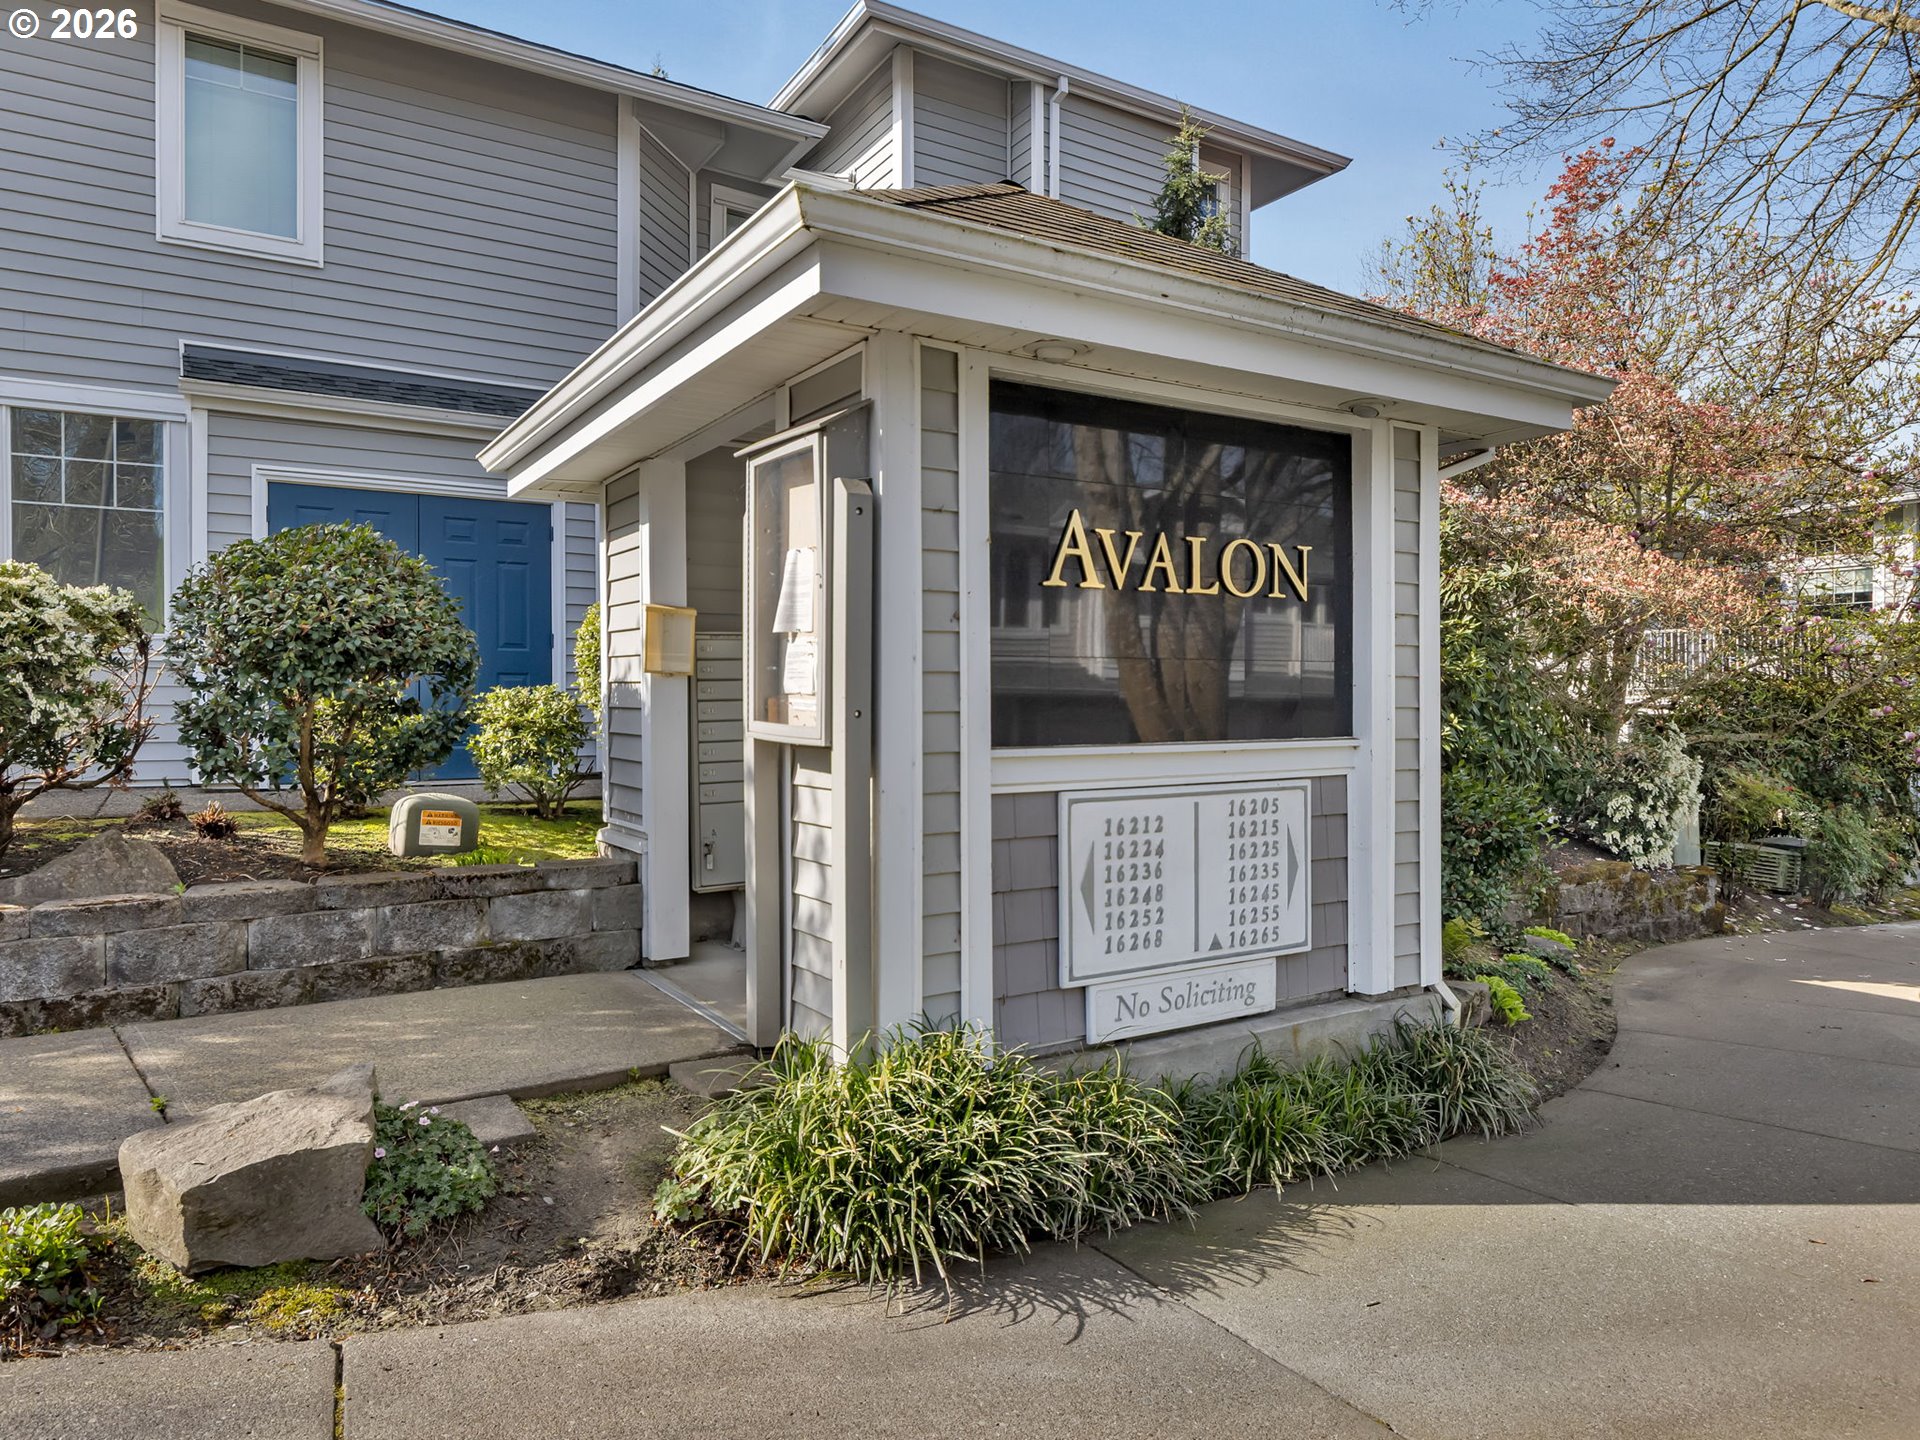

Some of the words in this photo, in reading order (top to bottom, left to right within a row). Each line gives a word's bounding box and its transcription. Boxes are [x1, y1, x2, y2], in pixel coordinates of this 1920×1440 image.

[1041, 508, 1313, 602] AVALON
[1228, 798, 1279, 817] 16205
[1105, 815, 1164, 837] 16212
[1228, 819, 1279, 839] 16215
[1105, 839, 1164, 860] 16224
[1228, 840, 1279, 861] 16225
[1105, 861, 1163, 884] 16236
[1228, 862, 1279, 883] 16235
[1105, 884, 1163, 907] 16248
[1228, 883, 1279, 904] 16245
[1105, 907, 1164, 930] 16252
[1228, 905, 1279, 927] 16255
[1105, 929, 1163, 954] 16268
[1229, 926, 1280, 948] 16265
[1114, 991, 1151, 1023] No
[1158, 977, 1257, 1014] Soliciting
